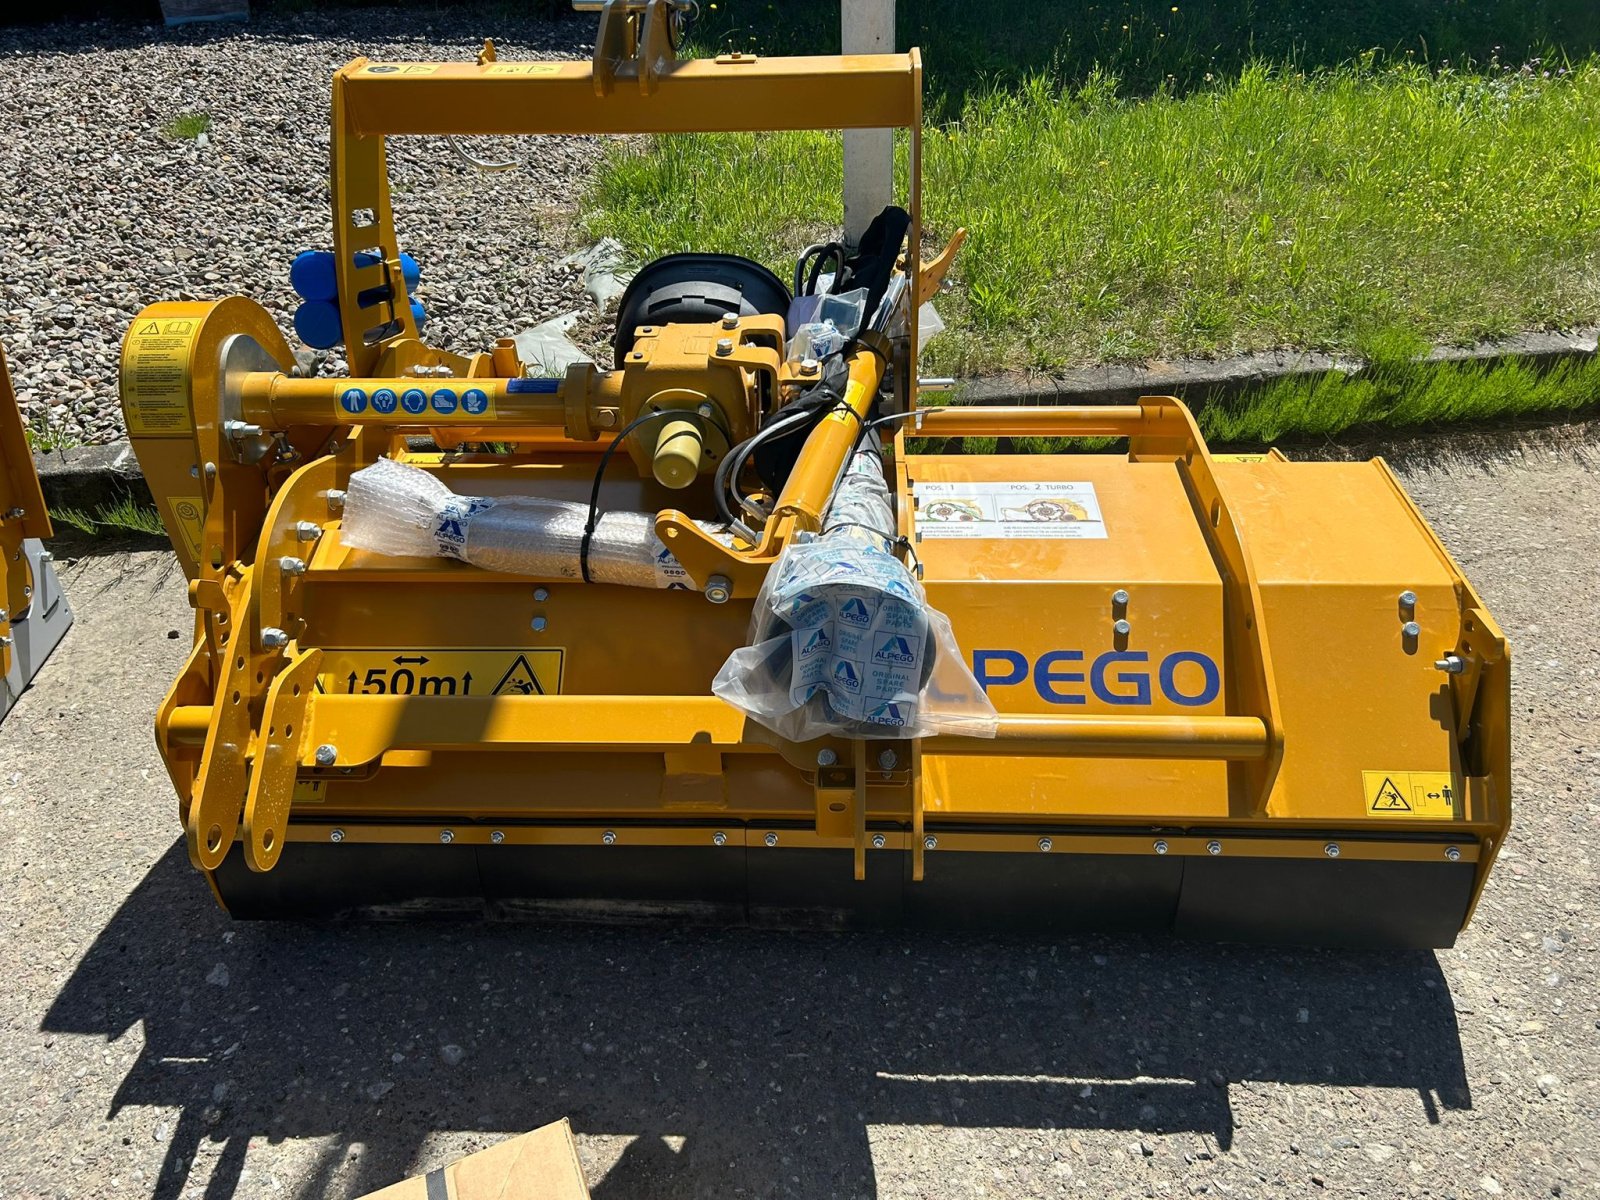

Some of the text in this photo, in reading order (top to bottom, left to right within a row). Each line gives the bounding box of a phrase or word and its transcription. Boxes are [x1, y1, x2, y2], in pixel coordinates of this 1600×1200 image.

[434, 531, 465, 544] ALPEGO
[875, 651, 914, 662] ALPEGO
[872, 670, 910, 680] ORIGINAL
[877, 679, 905, 687] SPARE
[876, 685, 904, 693] PARTS
[866, 716, 905, 727] ALPEGO
